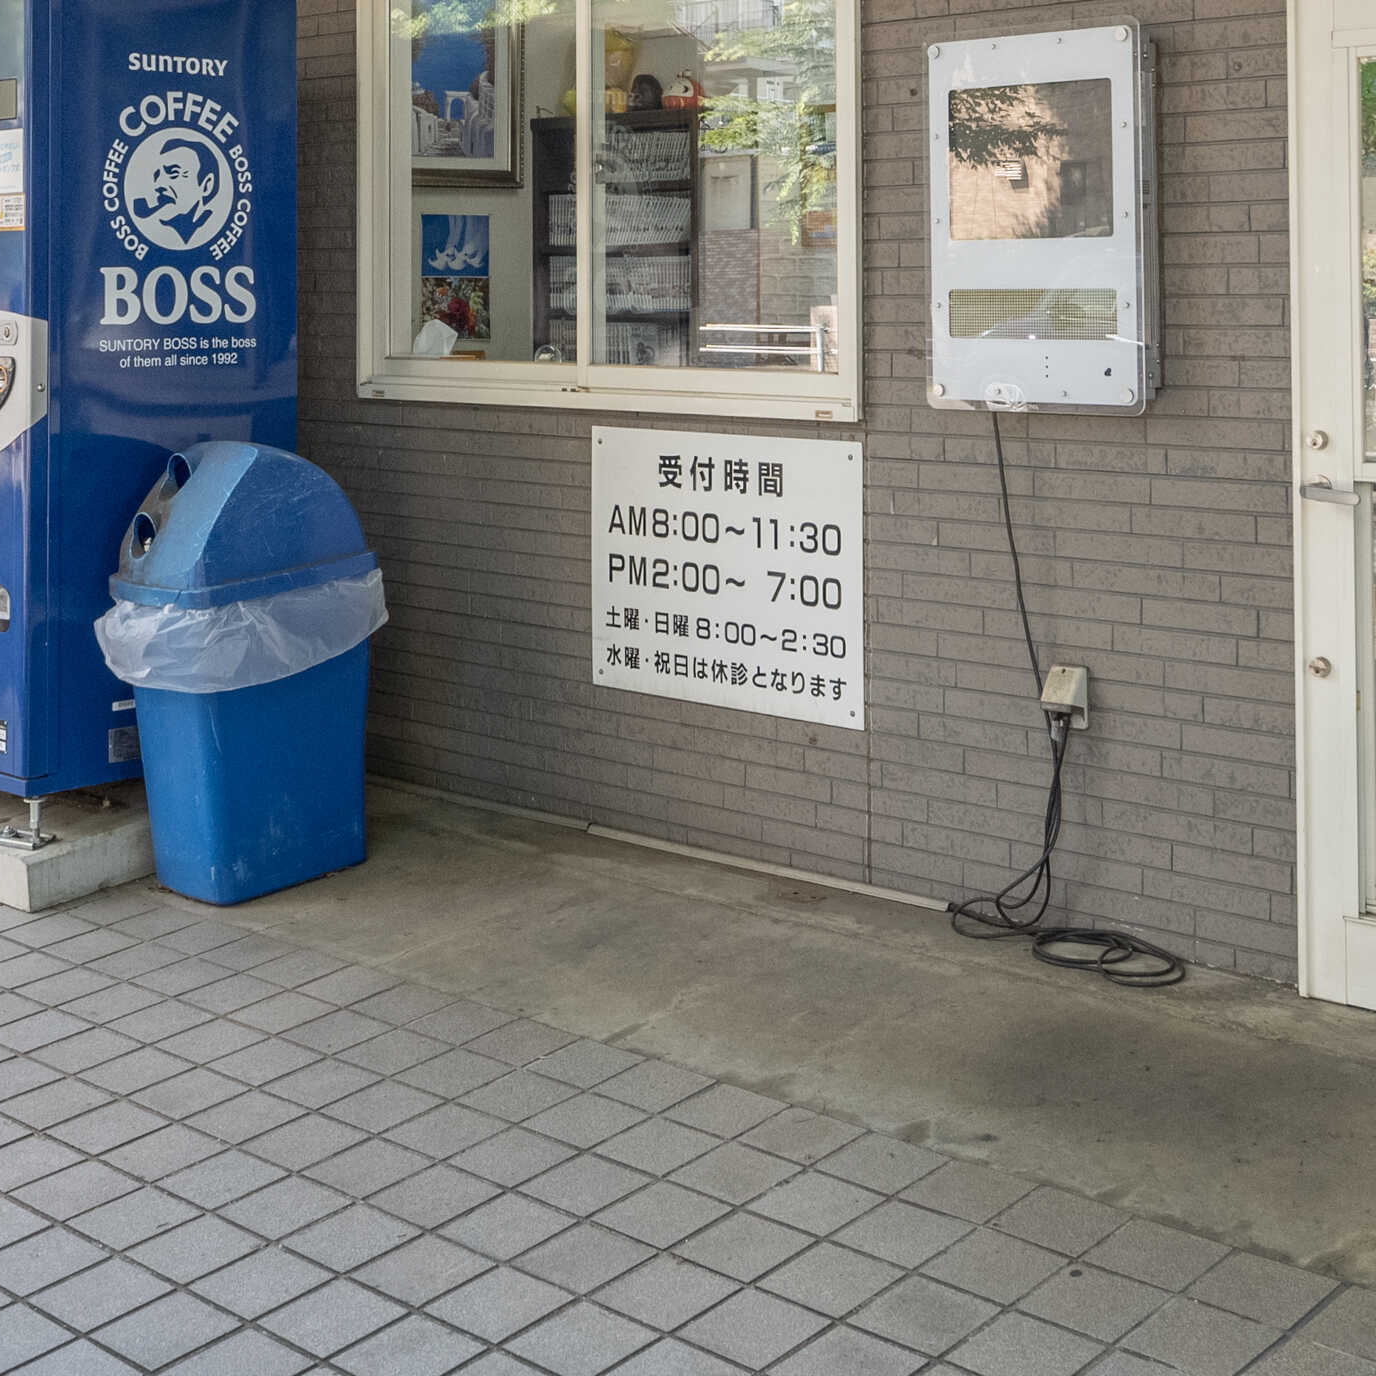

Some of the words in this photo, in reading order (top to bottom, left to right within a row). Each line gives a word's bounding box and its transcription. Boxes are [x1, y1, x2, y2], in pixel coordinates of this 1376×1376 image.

[128, 52, 229, 76] SUNTORY
[119, 91, 239, 143] COFFEE
[102, 139, 128, 212] COFFEE
[229, 144, 252, 193] BOSS
[110, 215, 149, 261] BOSS
[209, 199, 251, 261] COFFEE
[99, 266, 256, 325] BOSS
[99, 338, 160, 352] SUNTORY
[163, 337, 197, 350] BOSS
[200, 337, 210, 349] is
[212, 337, 229, 349] the
[231, 336, 256, 348] boss
[119, 356, 131, 368] of
[134, 356, 161, 367] them
[165, 354, 177, 366] all
[180, 354, 208, 365] since
[212, 352, 238, 364] 1992
[658, 454, 784, 497] 受付時間
[606, 643, 847, 700] 水曜・祝日は休診となります
